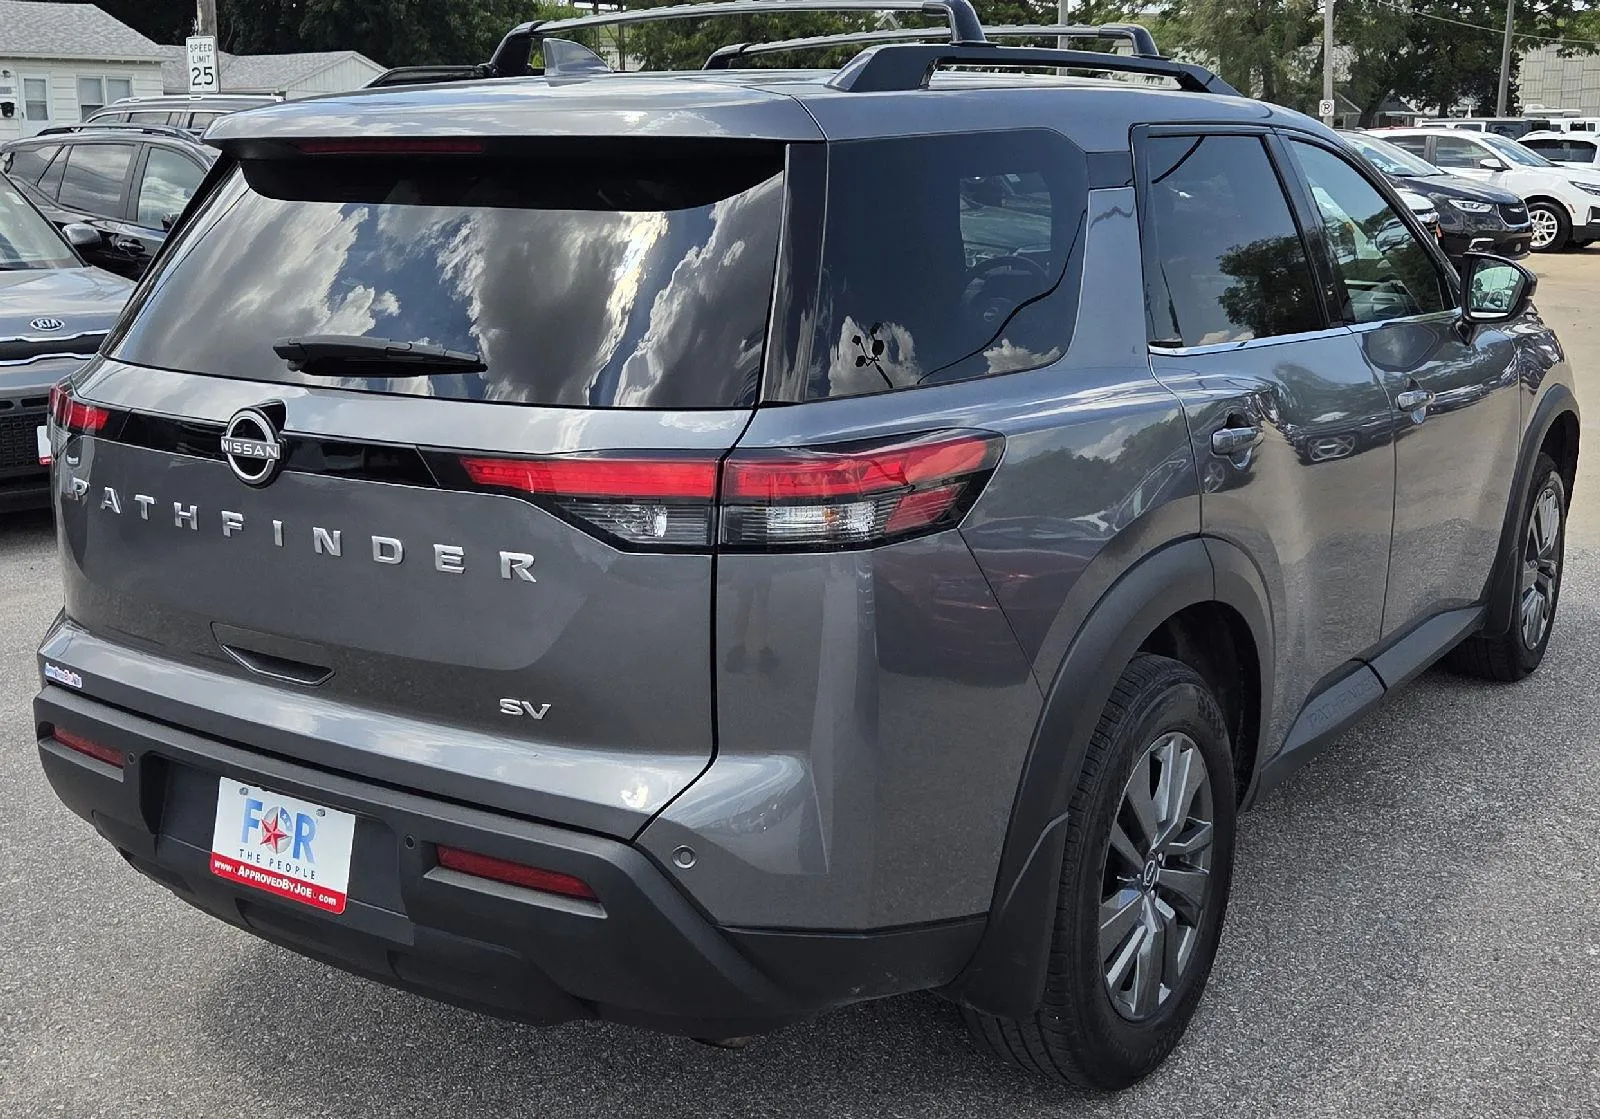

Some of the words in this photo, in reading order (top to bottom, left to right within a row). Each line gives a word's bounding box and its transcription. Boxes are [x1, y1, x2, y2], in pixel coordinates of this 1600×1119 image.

[190, 43, 213, 53] SPEED
[192, 54, 211, 64] LIMIT
[191, 66, 214, 86] 25
[36, 319, 61, 328] KIA
[221, 438, 277, 458] NISSAN
[72, 477, 537, 583] PATHFINDER
[499, 698, 552, 720] SV
[241, 798, 317, 864] FOR
[239, 848, 261, 864] THE
[269, 857, 316, 880] PEOPLE
